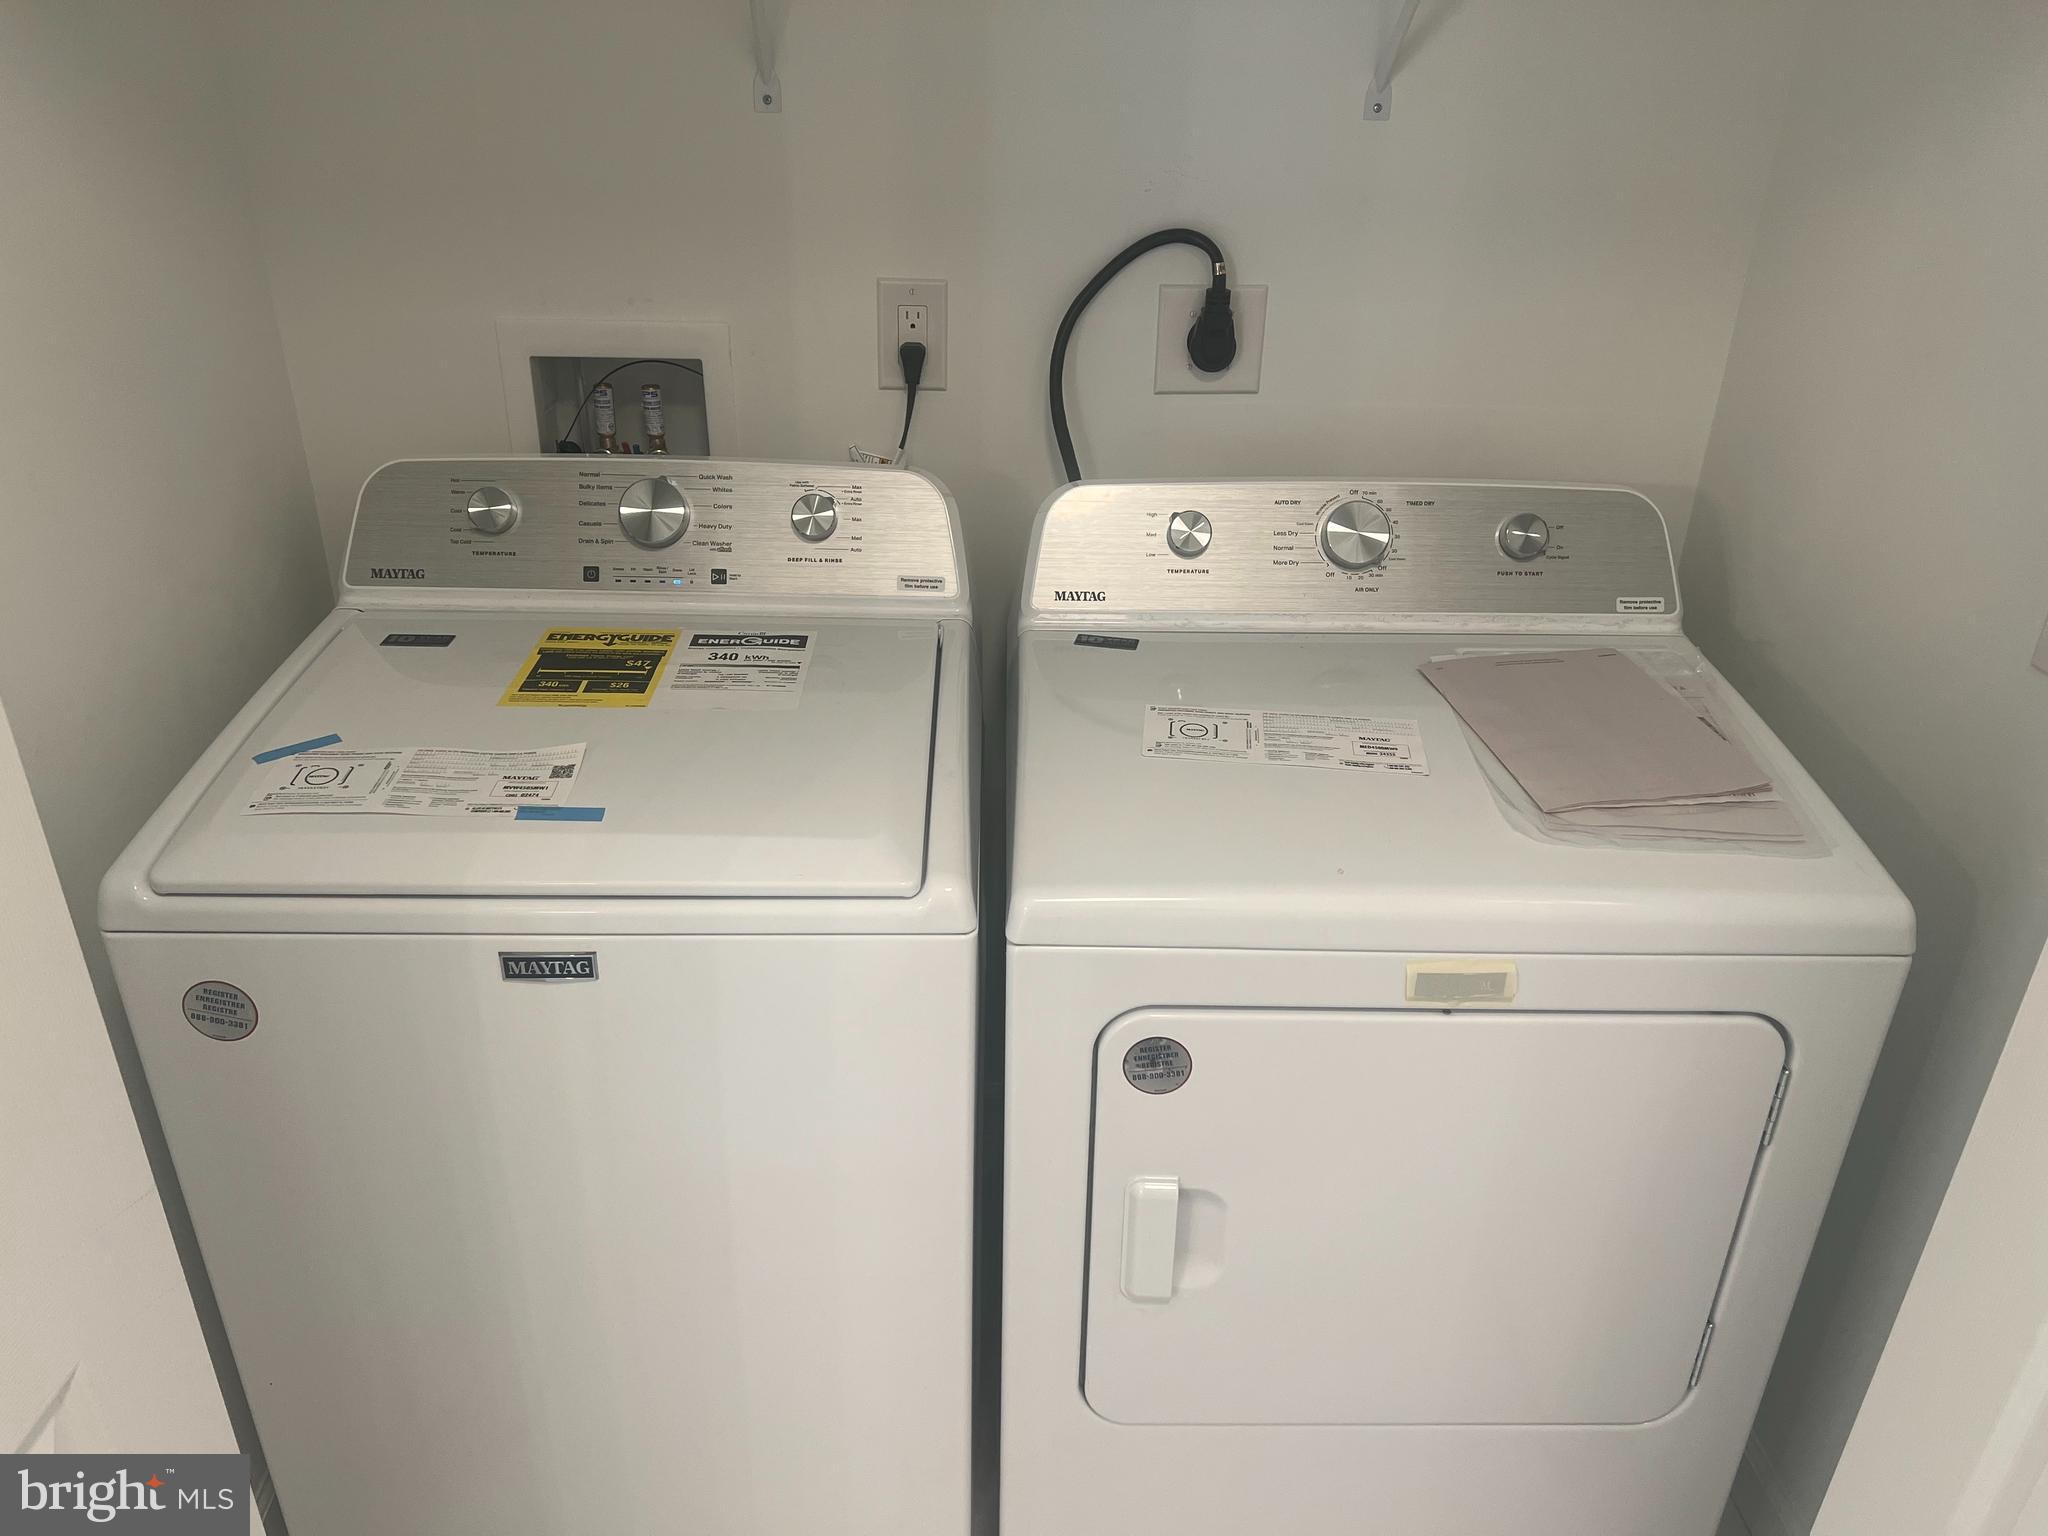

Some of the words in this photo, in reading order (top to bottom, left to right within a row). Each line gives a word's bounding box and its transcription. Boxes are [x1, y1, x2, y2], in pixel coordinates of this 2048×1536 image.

[371, 568, 425, 579] MAYTAG
[1054, 591, 1106, 602] MAYTAG
[546, 633, 675, 645] ENERGYGUIDE
[698, 637, 800, 645] ENERGUIDE
[708, 652, 739, 661] 340
[508, 960, 590, 976] MAYTAG
[203, 988, 238, 1000] REGISTER
[196, 995, 245, 1009] ENREGISTRER
[203, 1004, 237, 1016] REGISTRE
[1140, 1045, 1171, 1053] REGISTER
[1134, 1052, 1178, 1061] ENREGISTRER
